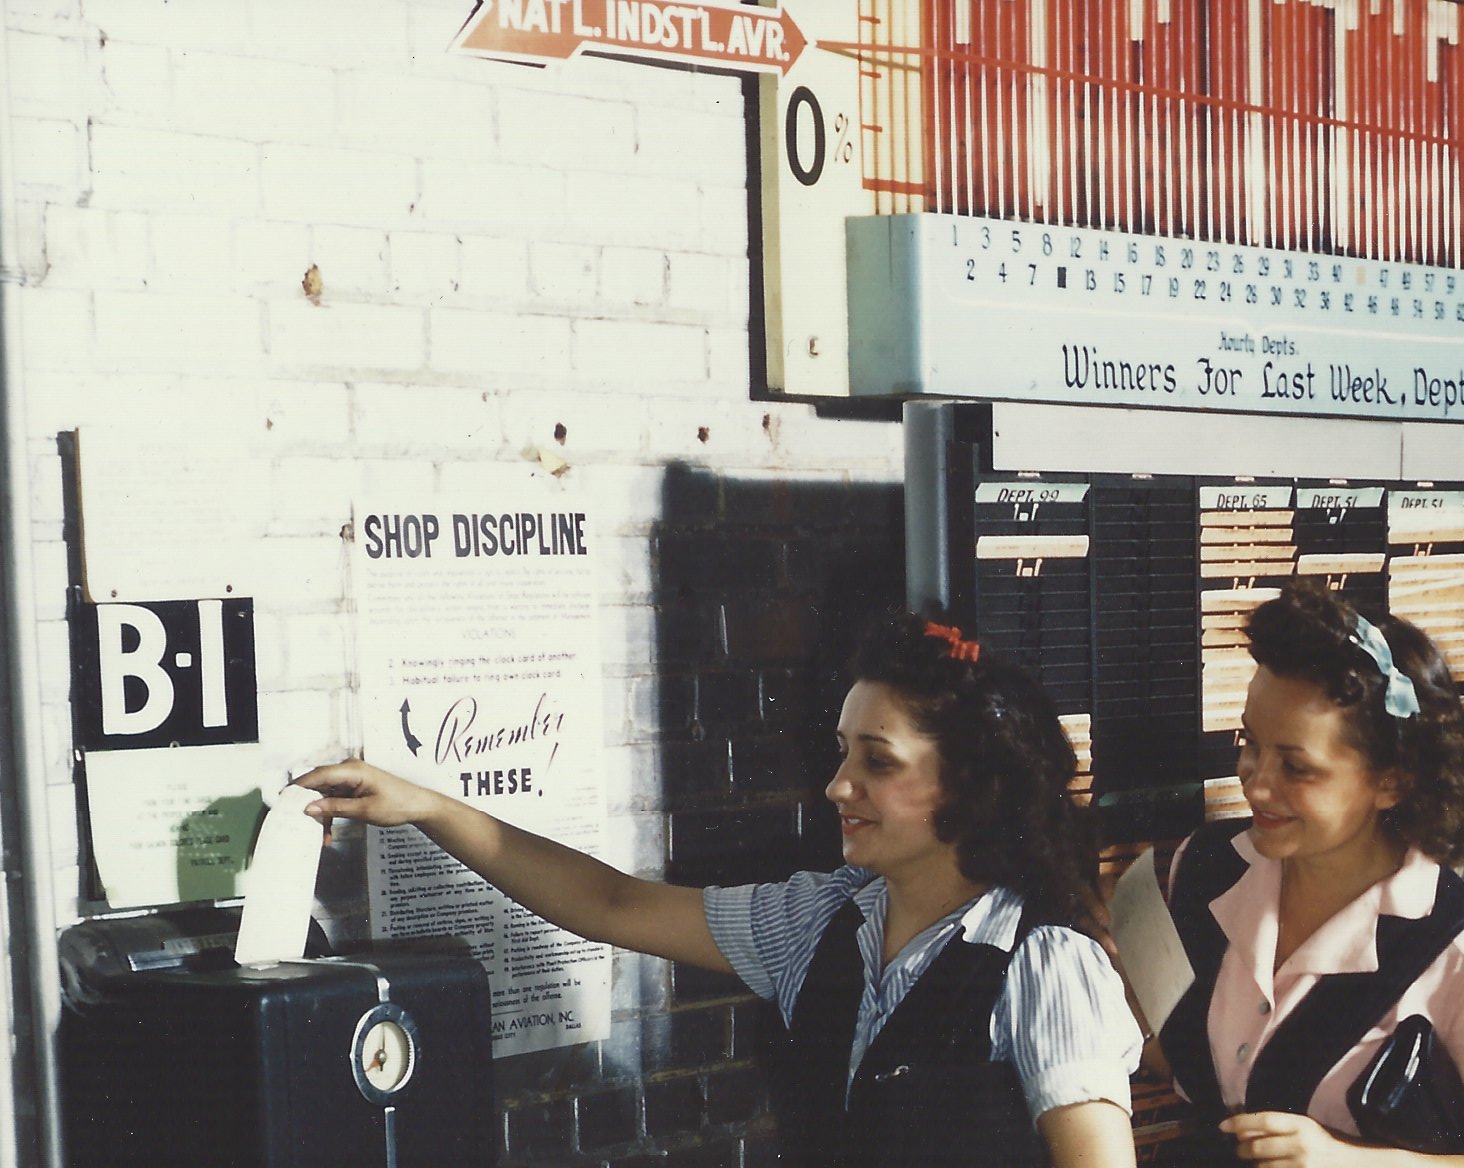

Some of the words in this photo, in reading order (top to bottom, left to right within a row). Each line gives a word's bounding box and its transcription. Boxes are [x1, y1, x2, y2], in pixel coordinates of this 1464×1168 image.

[727, 14, 790, 61] AVR.
[953, 224, 958, 247] 1
[981, 226, 990, 249] 3
[1012, 230, 1022, 252] 5
[1043, 233, 1052, 256] 8
[1070, 236, 1081, 258] 12
[1181, 248, 1193, 269] 20
[1207, 250, 1220, 272] 23
[1308, 261, 1320, 281] 33
[967, 258, 975, 281] 2
[998, 262, 1007, 283] 4
[1028, 263, 1037, 285] 7
[1085, 269, 1097, 291] 13
[1114, 272, 1126, 293] 15
[1141, 274, 1152, 296] 17
[1194, 279, 1206, 300] 22
[1220, 281, 1231, 302] 24
[1062, 343, 1177, 394] Winners
[1197, 357, 1243, 397] For
[1260, 361, 1316, 400] Last
[997, 488, 1034, 502] DEPT.
[1216, 494, 1249, 508] DEPT.
[1252, 494, 1268, 508] 65
[364, 513, 440, 559] SHOP
[452, 512, 588, 558] DISCIPLINE
[402, 657, 444, 669] Knowingly
[479, 655, 490, 665] the
[495, 653, 515, 664] clock
[518, 653, 536, 664] card
[402, 674, 438, 685] Habitual
[443, 672, 468, 684] failure
[473, 671, 481, 682] to
[484, 671, 500, 683] ring
[503, 672, 518, 681] own
[521, 670, 541, 681] clock
[434, 692, 564, 765] Remember
[510, 1011, 557, 1031] AVIATION,
